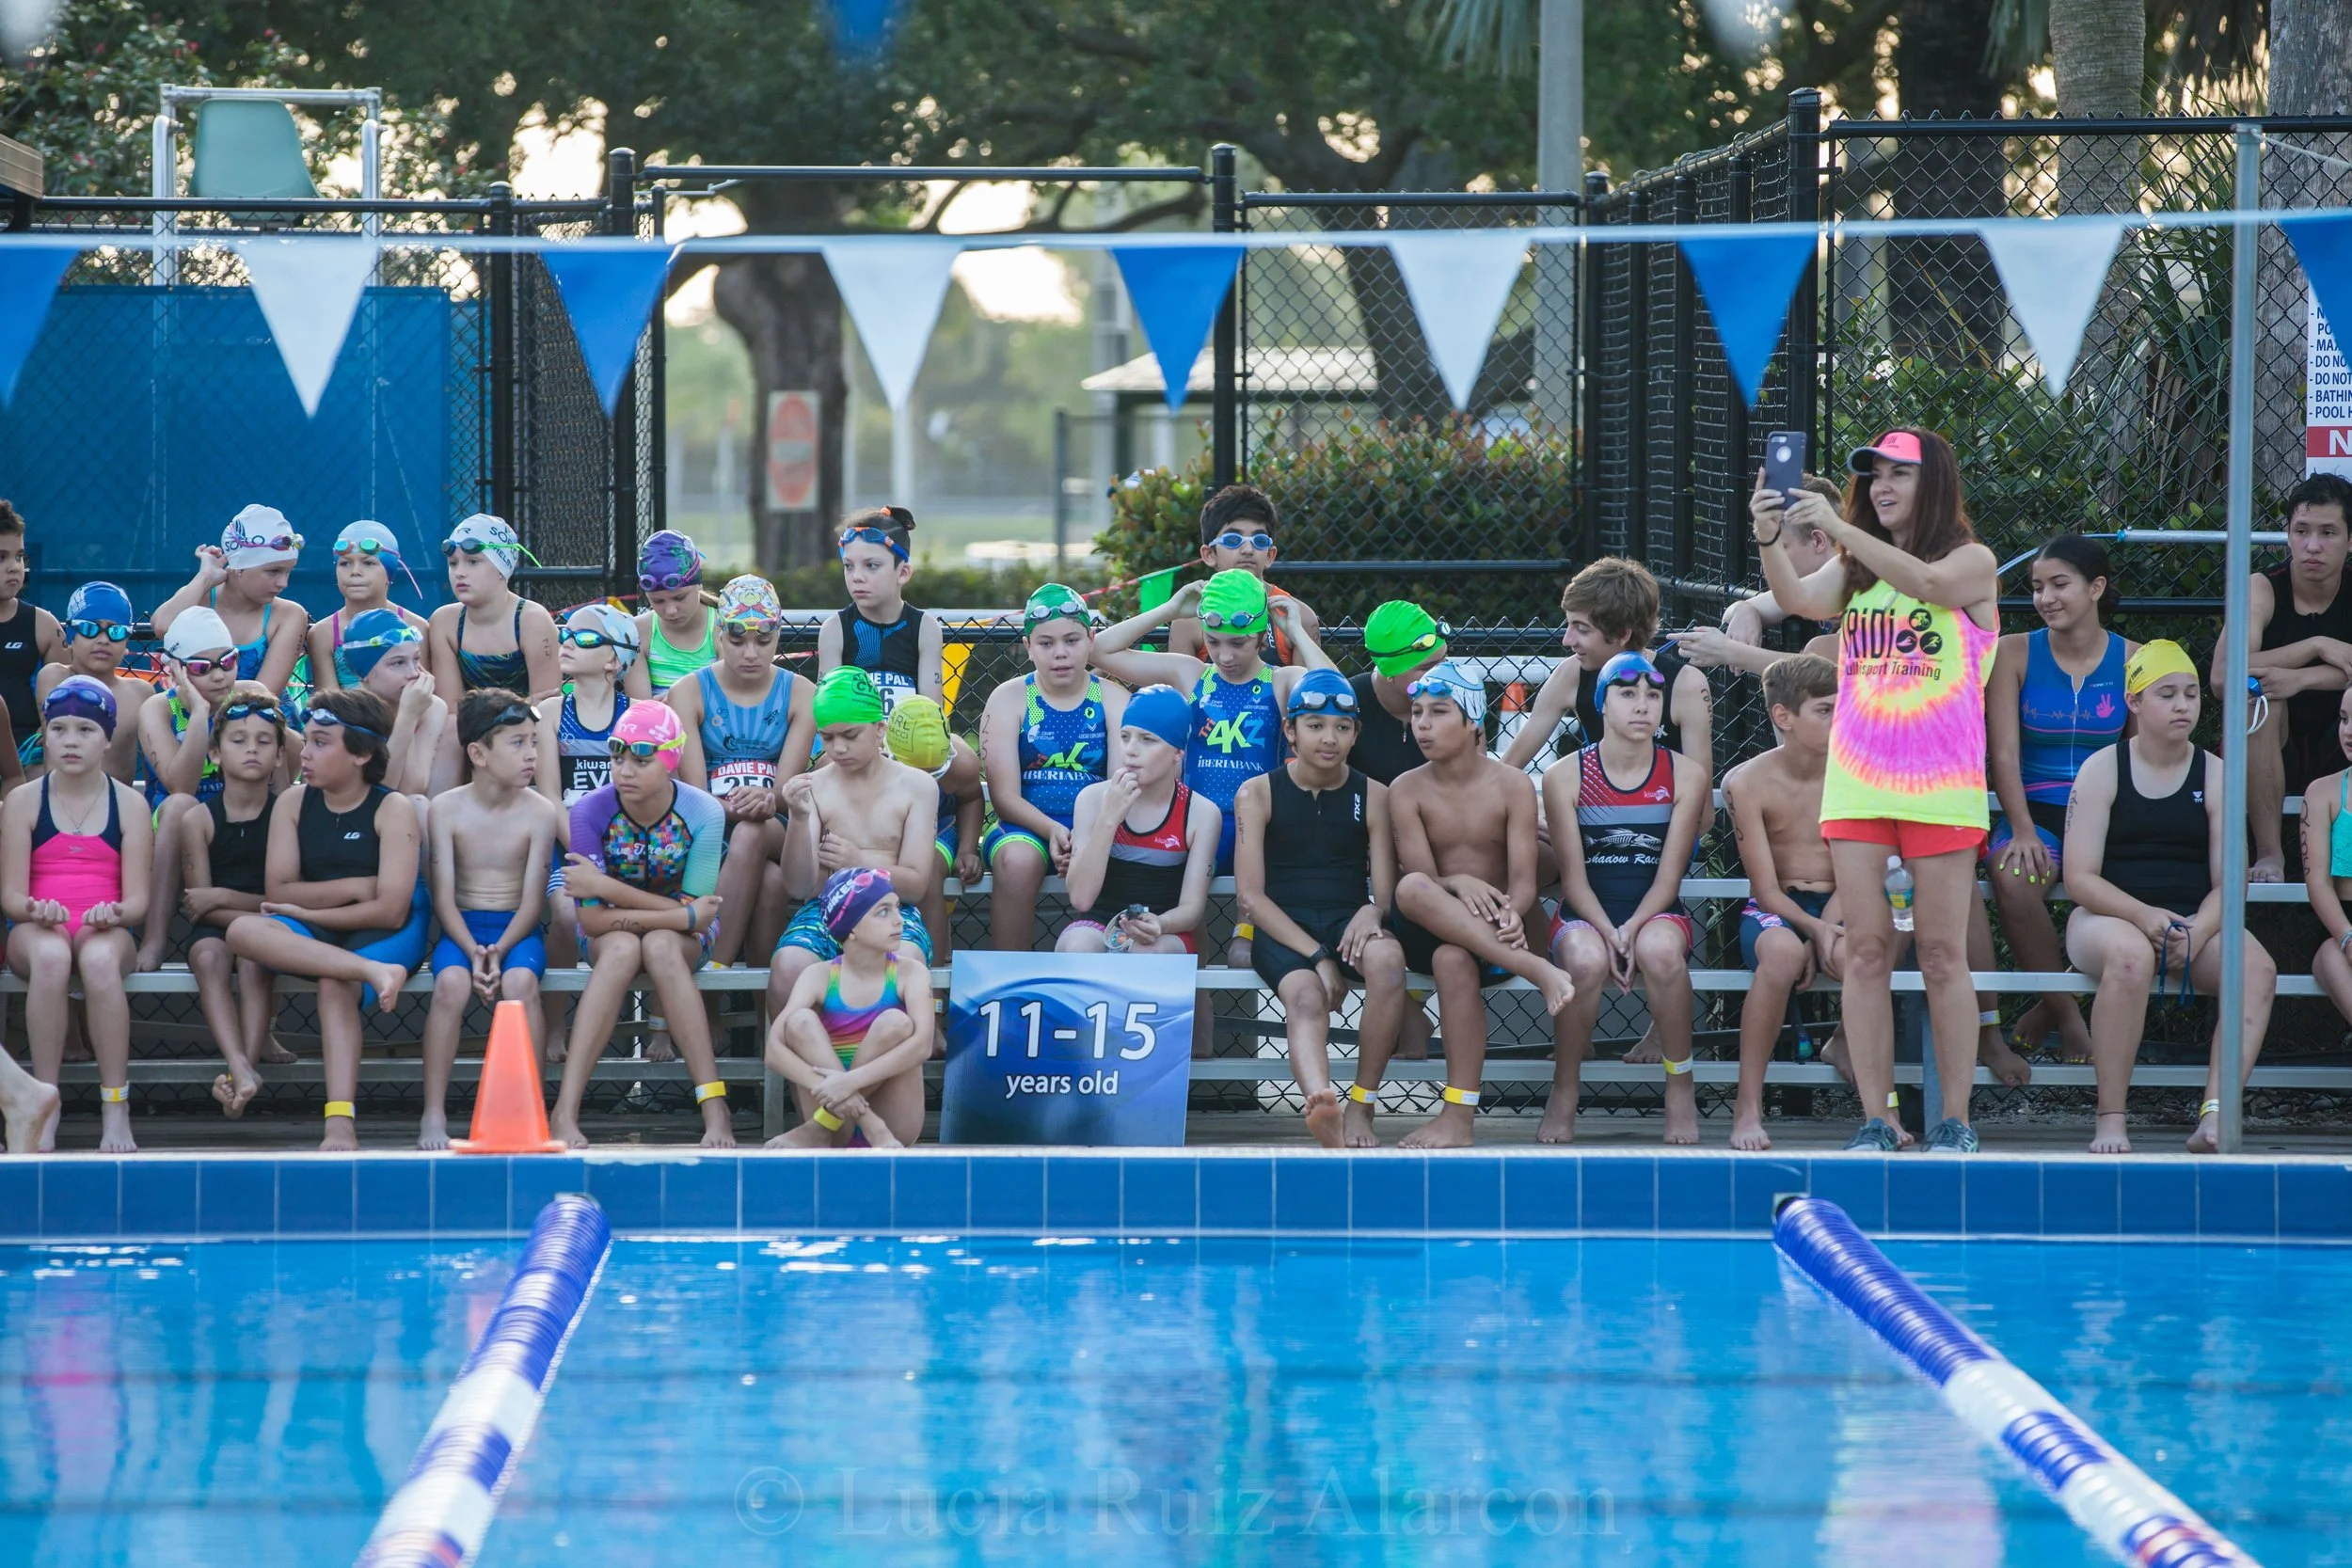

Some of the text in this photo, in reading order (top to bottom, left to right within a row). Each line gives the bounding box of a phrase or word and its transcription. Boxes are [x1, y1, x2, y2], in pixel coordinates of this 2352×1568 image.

[2315, 356, 2347, 368] DO NO
[2315, 372, 2352, 385] DO NOT
[2315, 406, 2345, 419] POOL
[1891, 660, 1942, 681] Training
[884, 673, 909, 686] PAL
[575, 758, 612, 770] kiwa
[717, 762, 755, 776] DAVIE
[978, 999, 1159, 1061] 11-15
[1004, 1069, 1119, 1100] years old
